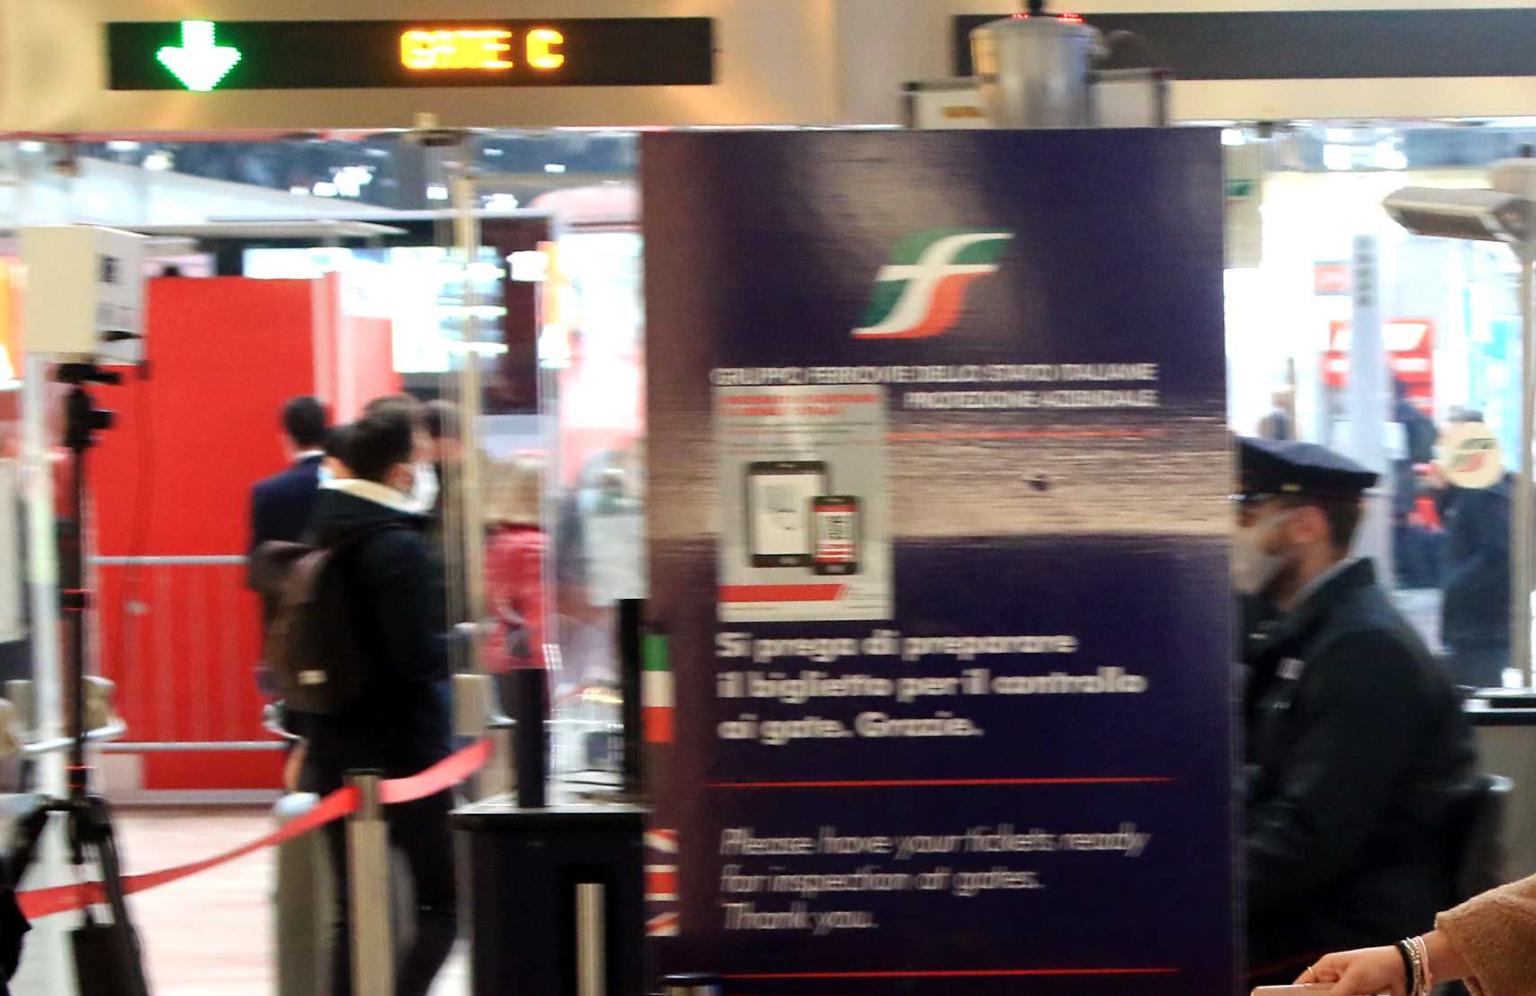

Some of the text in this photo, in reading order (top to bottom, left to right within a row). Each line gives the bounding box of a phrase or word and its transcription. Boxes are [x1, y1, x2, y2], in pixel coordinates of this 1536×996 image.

[400, 28, 565, 70] GATE C
[715, 629, 1079, 663] Si prega di preparare
[716, 666, 1148, 704] il biglietto per il controllo
[717, 713, 758, 740] ai
[854, 711, 985, 738] Grazie.
[720, 821, 1151, 860] Please have your tickets ready
[720, 864, 768, 892] for
[768, 865, 915, 898] inspection
[914, 866, 952, 891] at
[721, 901, 810, 930] Thank
